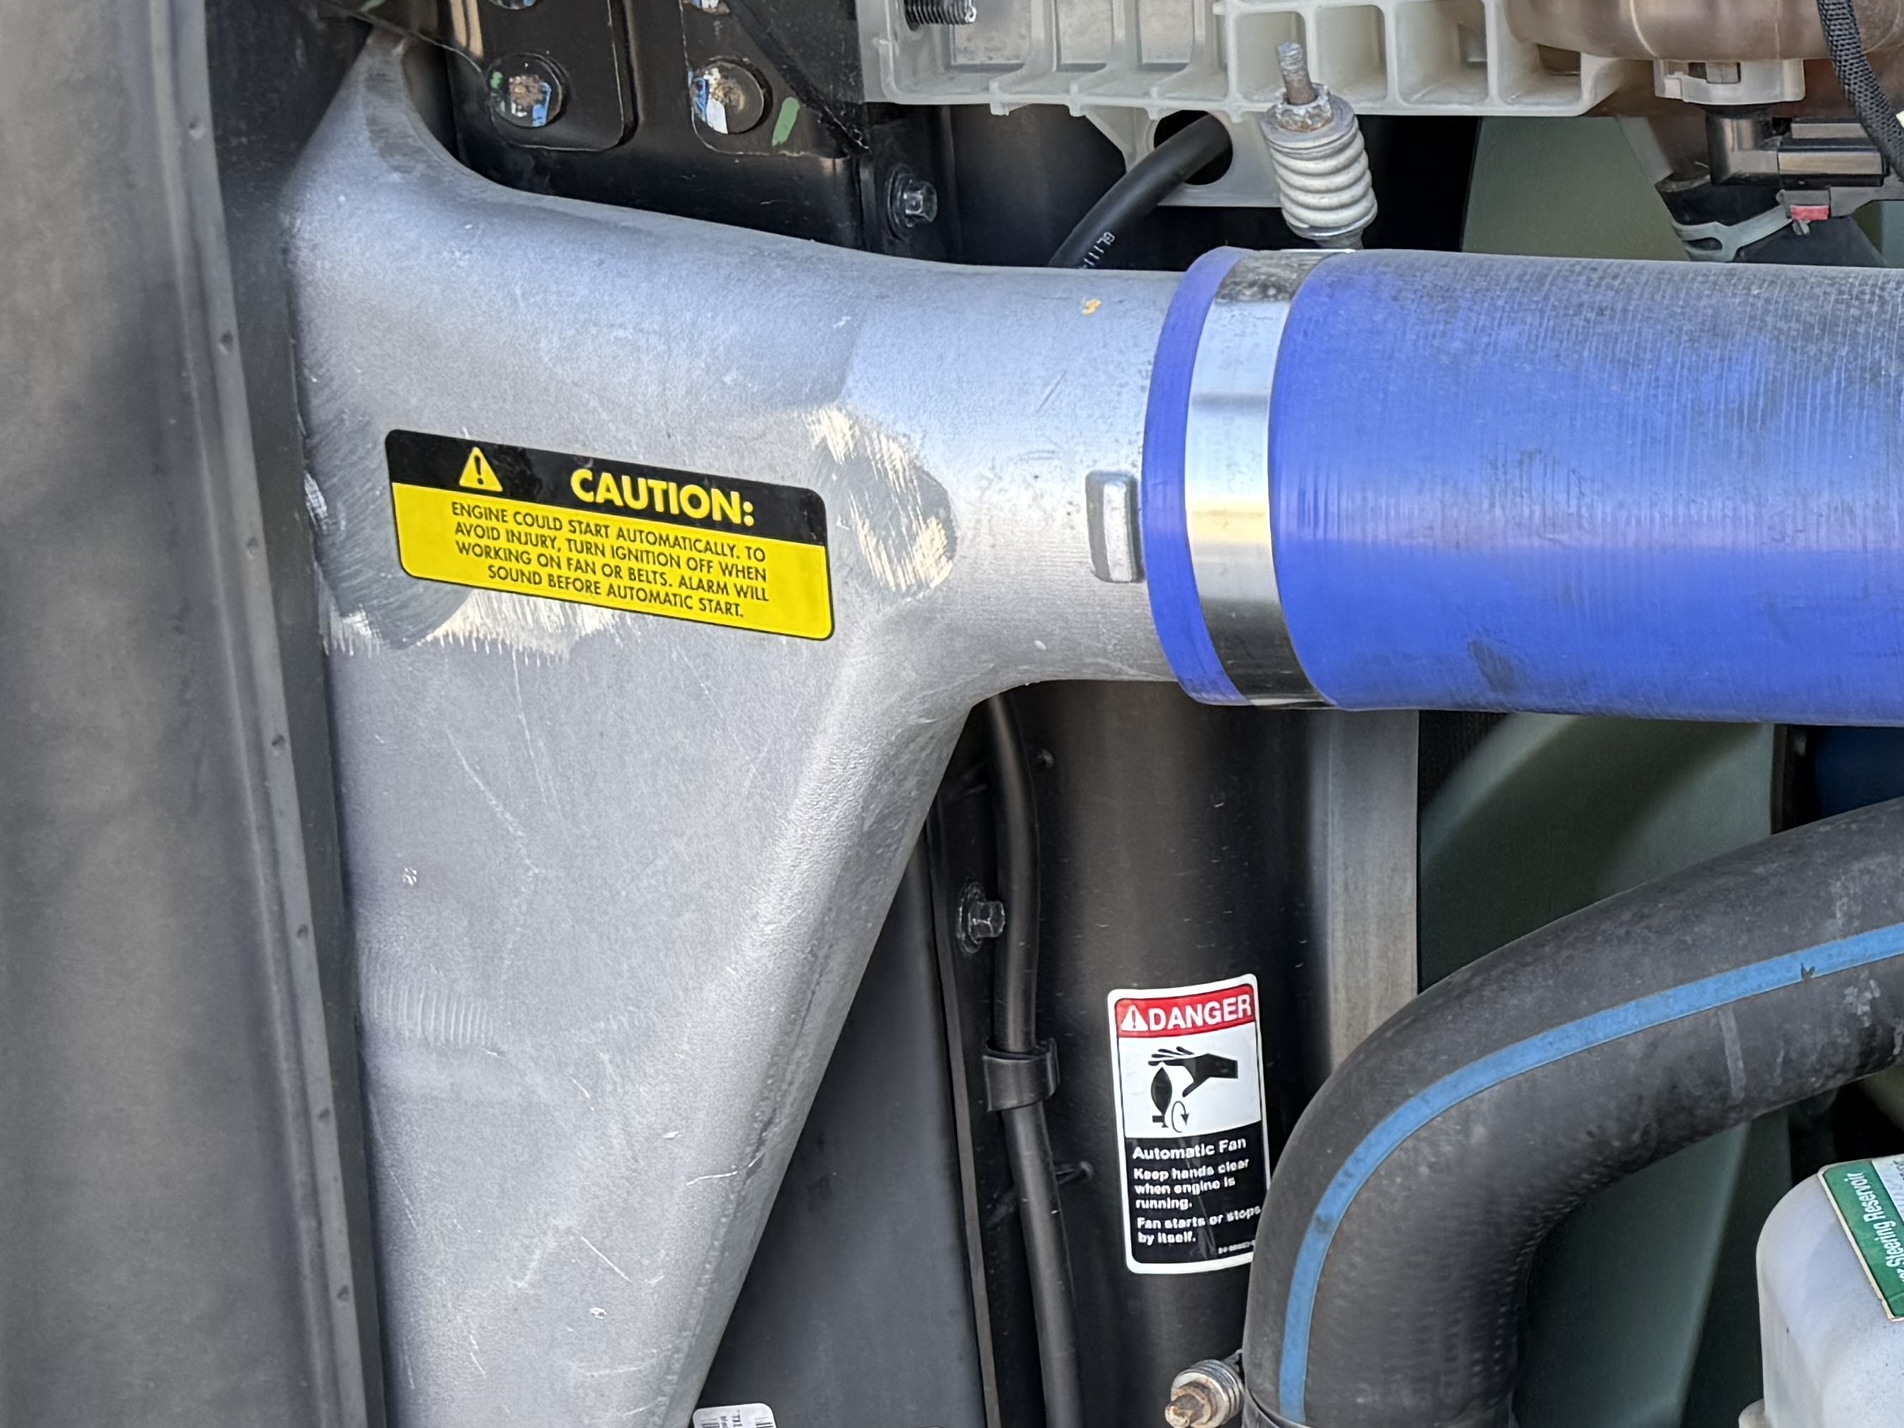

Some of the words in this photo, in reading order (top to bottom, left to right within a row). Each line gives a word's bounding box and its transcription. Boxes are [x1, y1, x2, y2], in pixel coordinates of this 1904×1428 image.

[570, 468, 756, 527] CAUTION:
[450, 501, 509, 524] ENGINE
[513, 511, 565, 531] COULD
[568, 519, 611, 539] START
[616, 526, 741, 560] AUTOMATICALLY.
[744, 545, 767, 563] TO
[454, 521, 503, 543] AVOID
[505, 529, 562, 553] INJURY,
[565, 537, 607, 557] TURN
[611, 544, 682, 568] IGNITION
[686, 555, 715, 573] OFF
[718, 562, 768, 583] WHEN
[455, 539, 533, 567] WORKING
[536, 552, 564, 570] ON
[566, 557, 597, 574] FAN
[600, 563, 625, 579] OR
[627, 565, 673, 587] BELTS.
[677, 574, 731, 596] ALARM
[733, 584, 769, 603] WILL
[487, 564, 543, 587] SOUND
[547, 574, 602, 597] BEFORE
[606, 583, 694, 611] AUTOMATIC
[697, 598, 745, 619] START.
[1147, 993, 1252, 1032] DANGER
[1132, 1143, 1216, 1161] Automatic
[1219, 1137, 1248, 1153] Fan
[1133, 1166, 1170, 1183] Keep
[1171, 1164, 1215, 1180] hands
[1217, 1158, 1250, 1175] clear
[1134, 1182, 1172, 1196] when
[1174, 1179, 1221, 1198] engine
[1223, 1176, 1236, 1189] is
[1135, 1195, 1193, 1212] running.
[1843, 1172, 1886, 1222] Reservoir
[1137, 1216, 1162, 1230] Fan
[1164, 1214, 1206, 1229] starts
[1208, 1212, 1224, 1226] or
[1137, 1231, 1155, 1247] by
[1157, 1230, 1197, 1244] itself.
